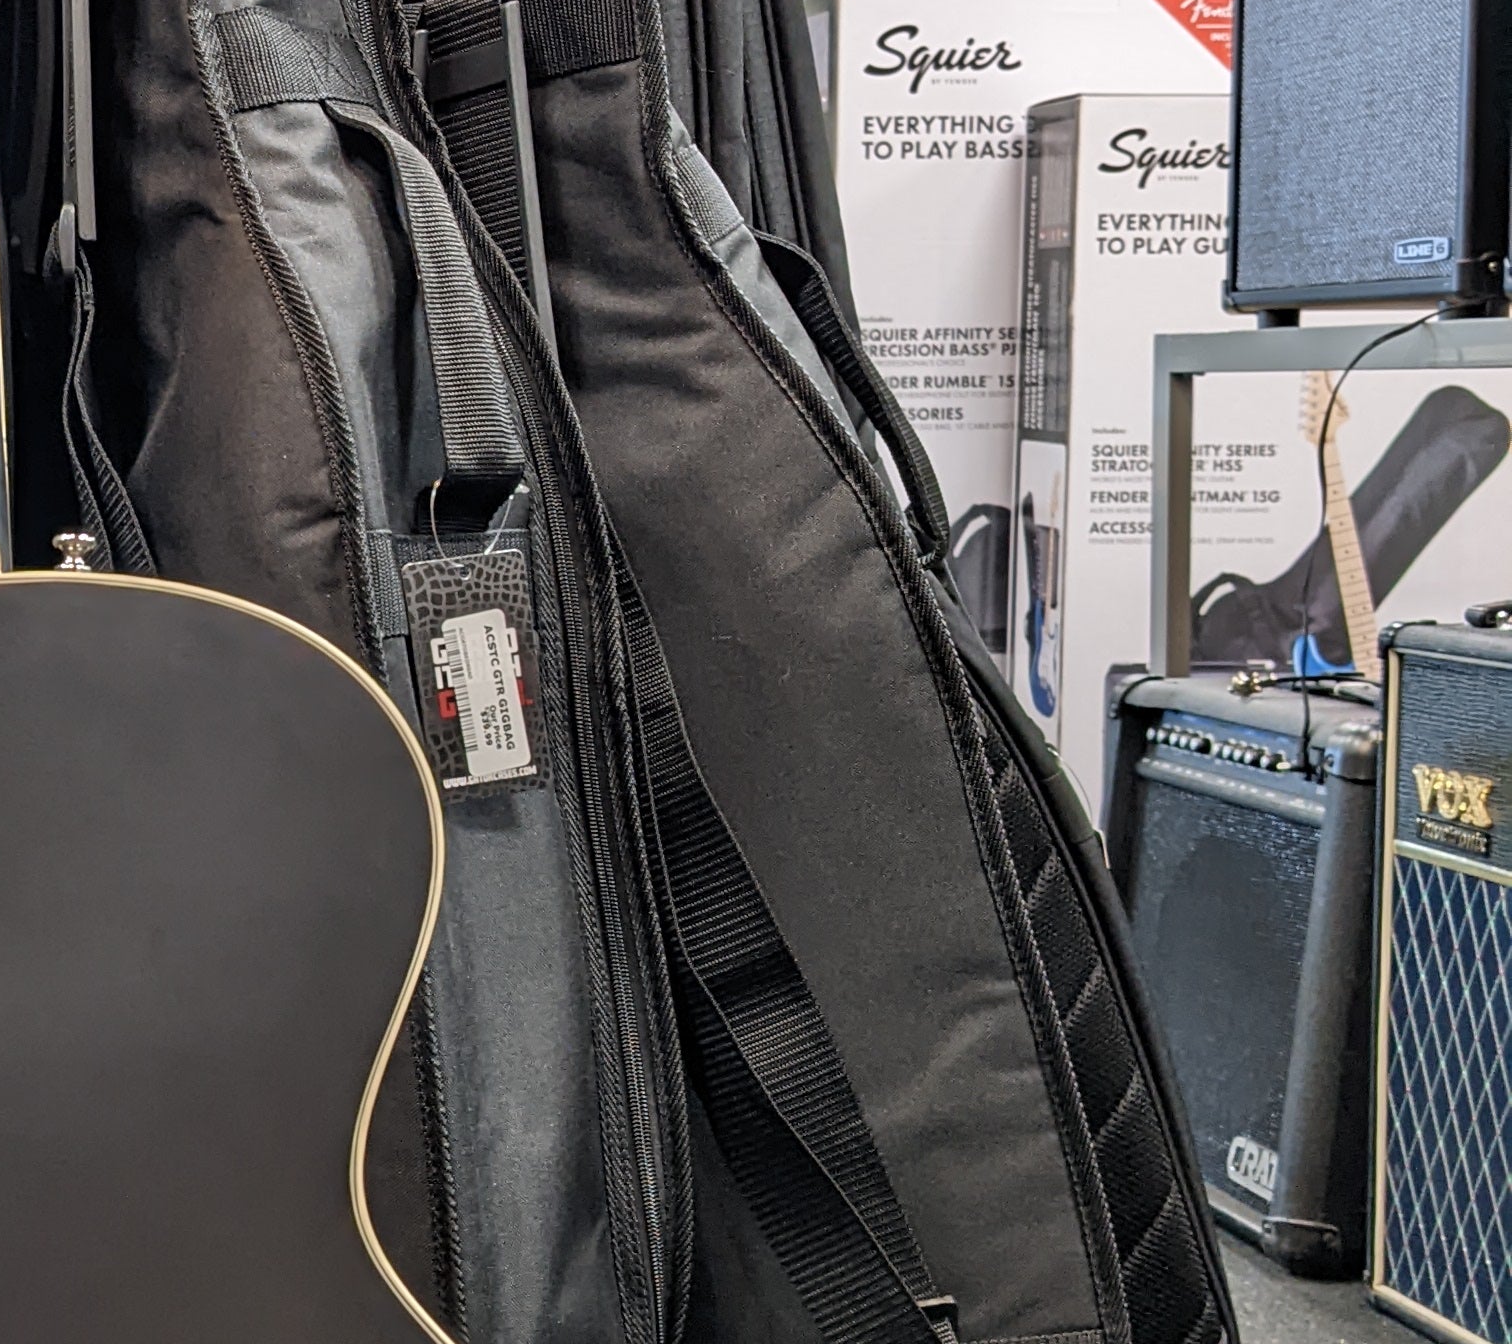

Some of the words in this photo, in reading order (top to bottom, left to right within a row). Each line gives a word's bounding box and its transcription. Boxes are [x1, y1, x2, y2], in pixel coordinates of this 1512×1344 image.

[863, 24, 1022, 94] Squier
[863, 115, 1014, 135] EVERYTHING
[862, 141, 893, 160] TO
[901, 141, 958, 159] PLAY
[965, 141, 1023, 159] BASS
[1097, 128, 1231, 189] Squier
[1096, 237, 1125, 255] TO
[1133, 237, 1187, 255] PLAY
[1398, 243, 1433, 258] LINE
[1436, 242, 1445, 254] 6
[861, 328, 919, 342] SQUIER
[923, 327, 994, 341] AFFINITY
[886, 376, 919, 389] DER
[903, 407, 964, 421] SORIES
[1091, 444, 1149, 458] SQUIER
[1212, 459, 1243, 472] HSS
[1090, 490, 1149, 504] FENDER
[1252, 490, 1281, 504] 15G
[483, 624, 500, 666] ACSTC
[492, 666, 505, 697] GTR
[488, 704, 498, 724] Our
[494, 725, 503, 750] Price
[498, 698, 516, 751] GIGBAG
[1412, 763, 1493, 829] VOX
[1227, 1136, 1278, 1191] CRAT
